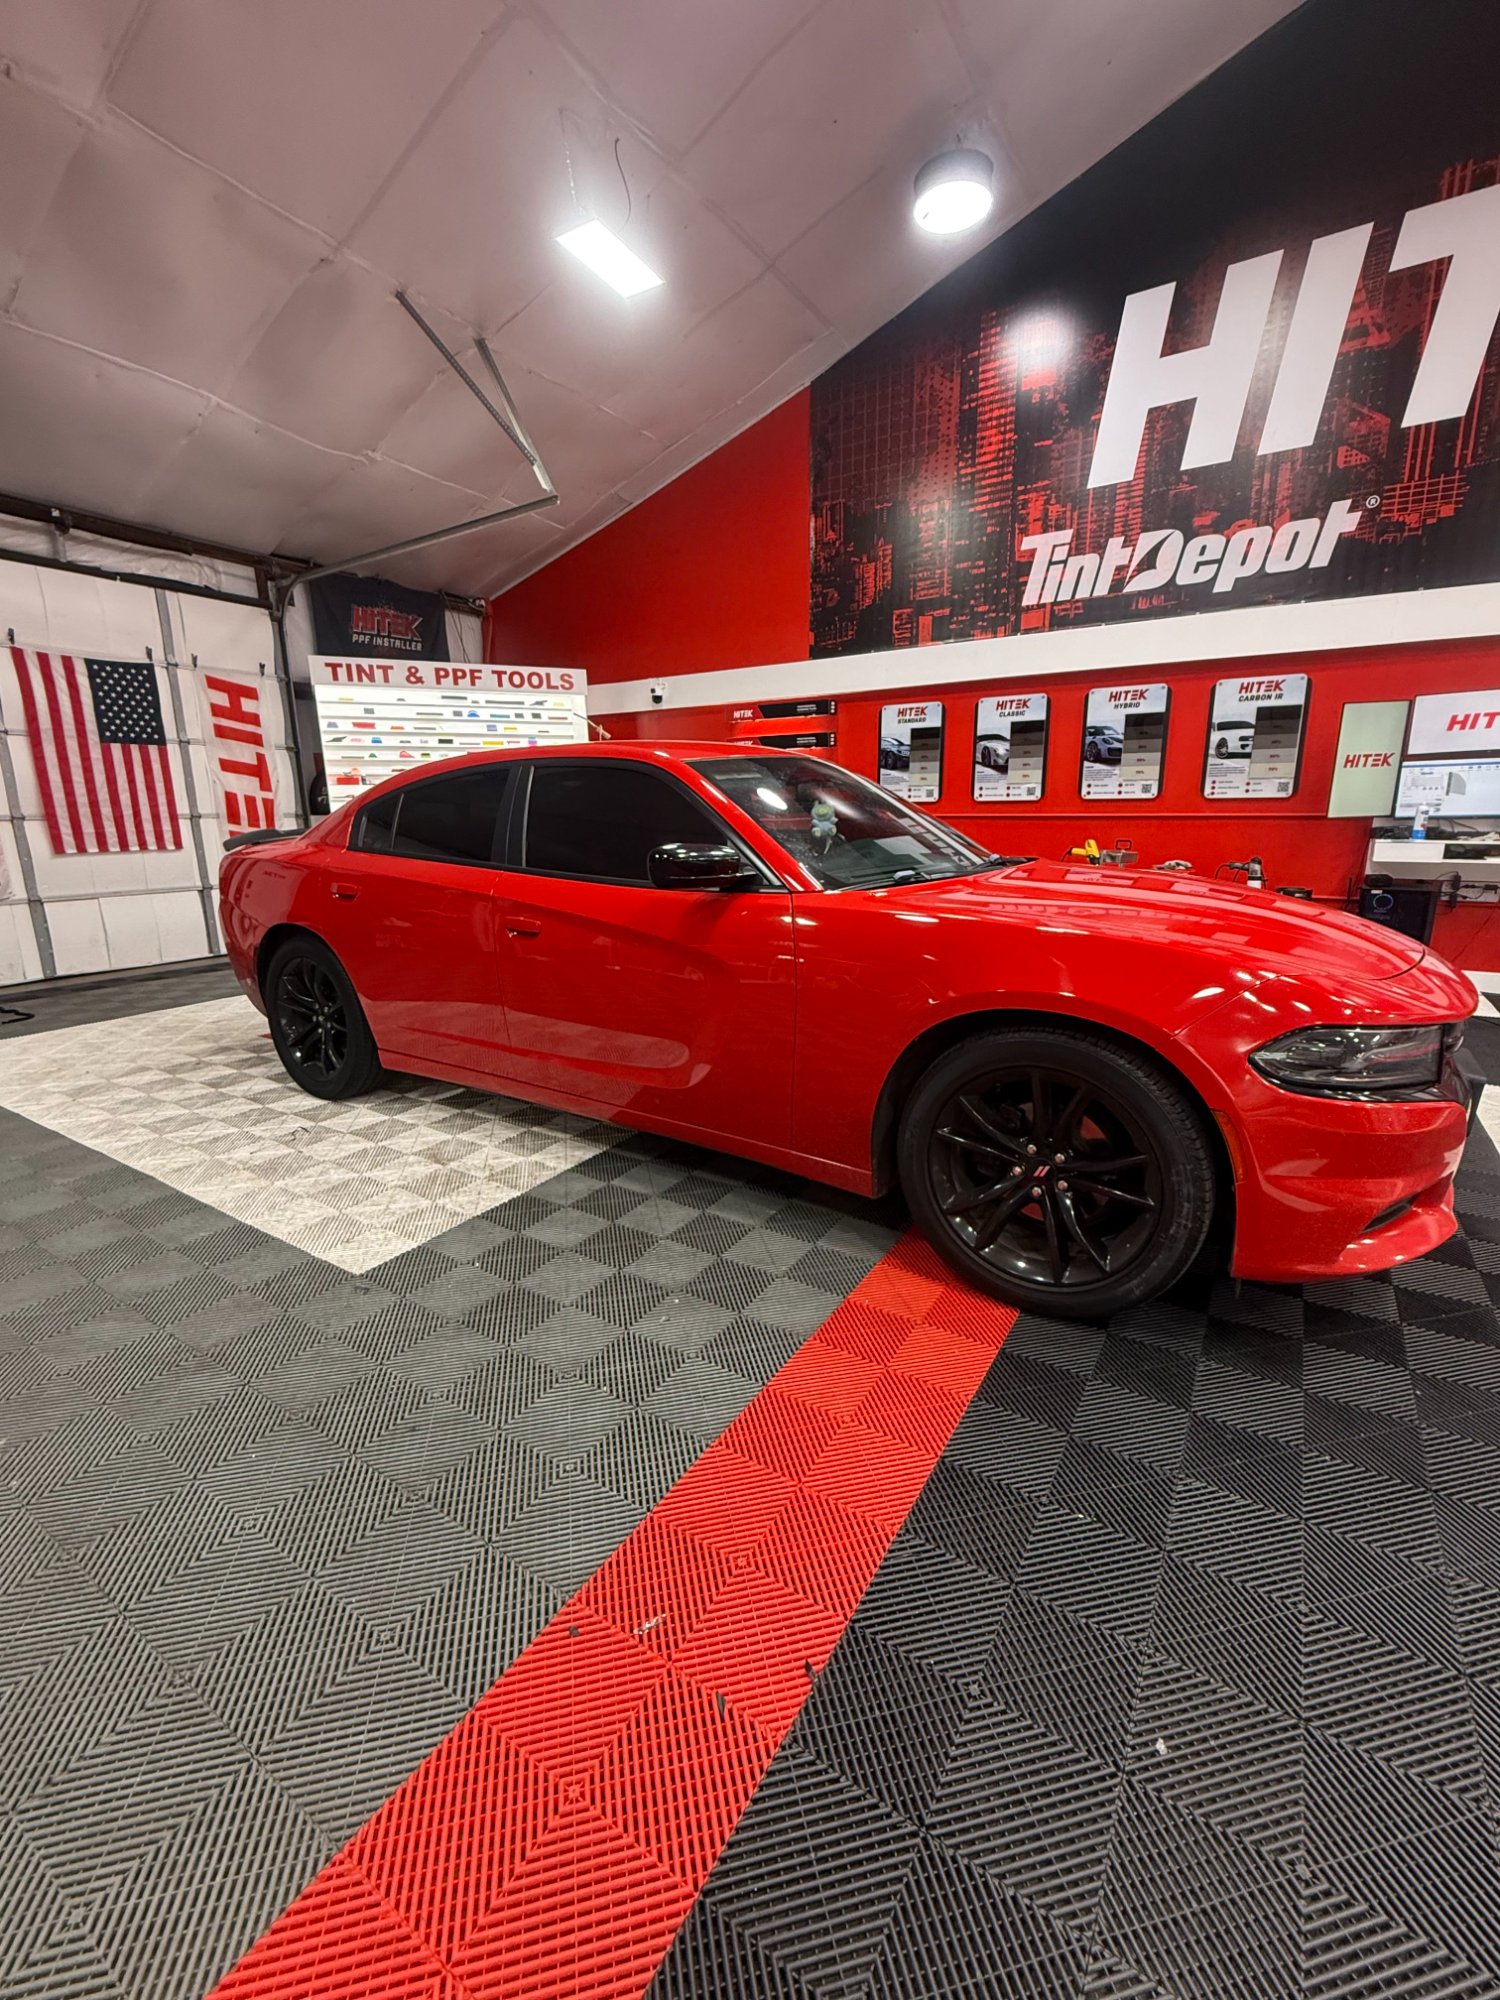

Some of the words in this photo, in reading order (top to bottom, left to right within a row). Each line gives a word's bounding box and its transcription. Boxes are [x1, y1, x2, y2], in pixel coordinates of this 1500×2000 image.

[351, 604, 423, 641] HITEK
[352, 634, 371, 645] PPF
[373, 636, 422, 652] INSTALLER
[324, 662, 394, 684] TINT
[405, 665, 425, 685] &
[434, 667, 483, 687] PPF
[491, 670, 574, 691] TOOLS
[1238, 679, 1286, 694] HITEK
[1109, 689, 1149, 702] HITEK
[1238, 694, 1272, 702] CARBON
[897, 706, 928, 718] HITEK
[995, 698, 1031, 711] HITEK
[733, 709, 753, 719] HITEK
[205, 674, 276, 838] HITE
[1343, 752, 1395, 768] HITEK
